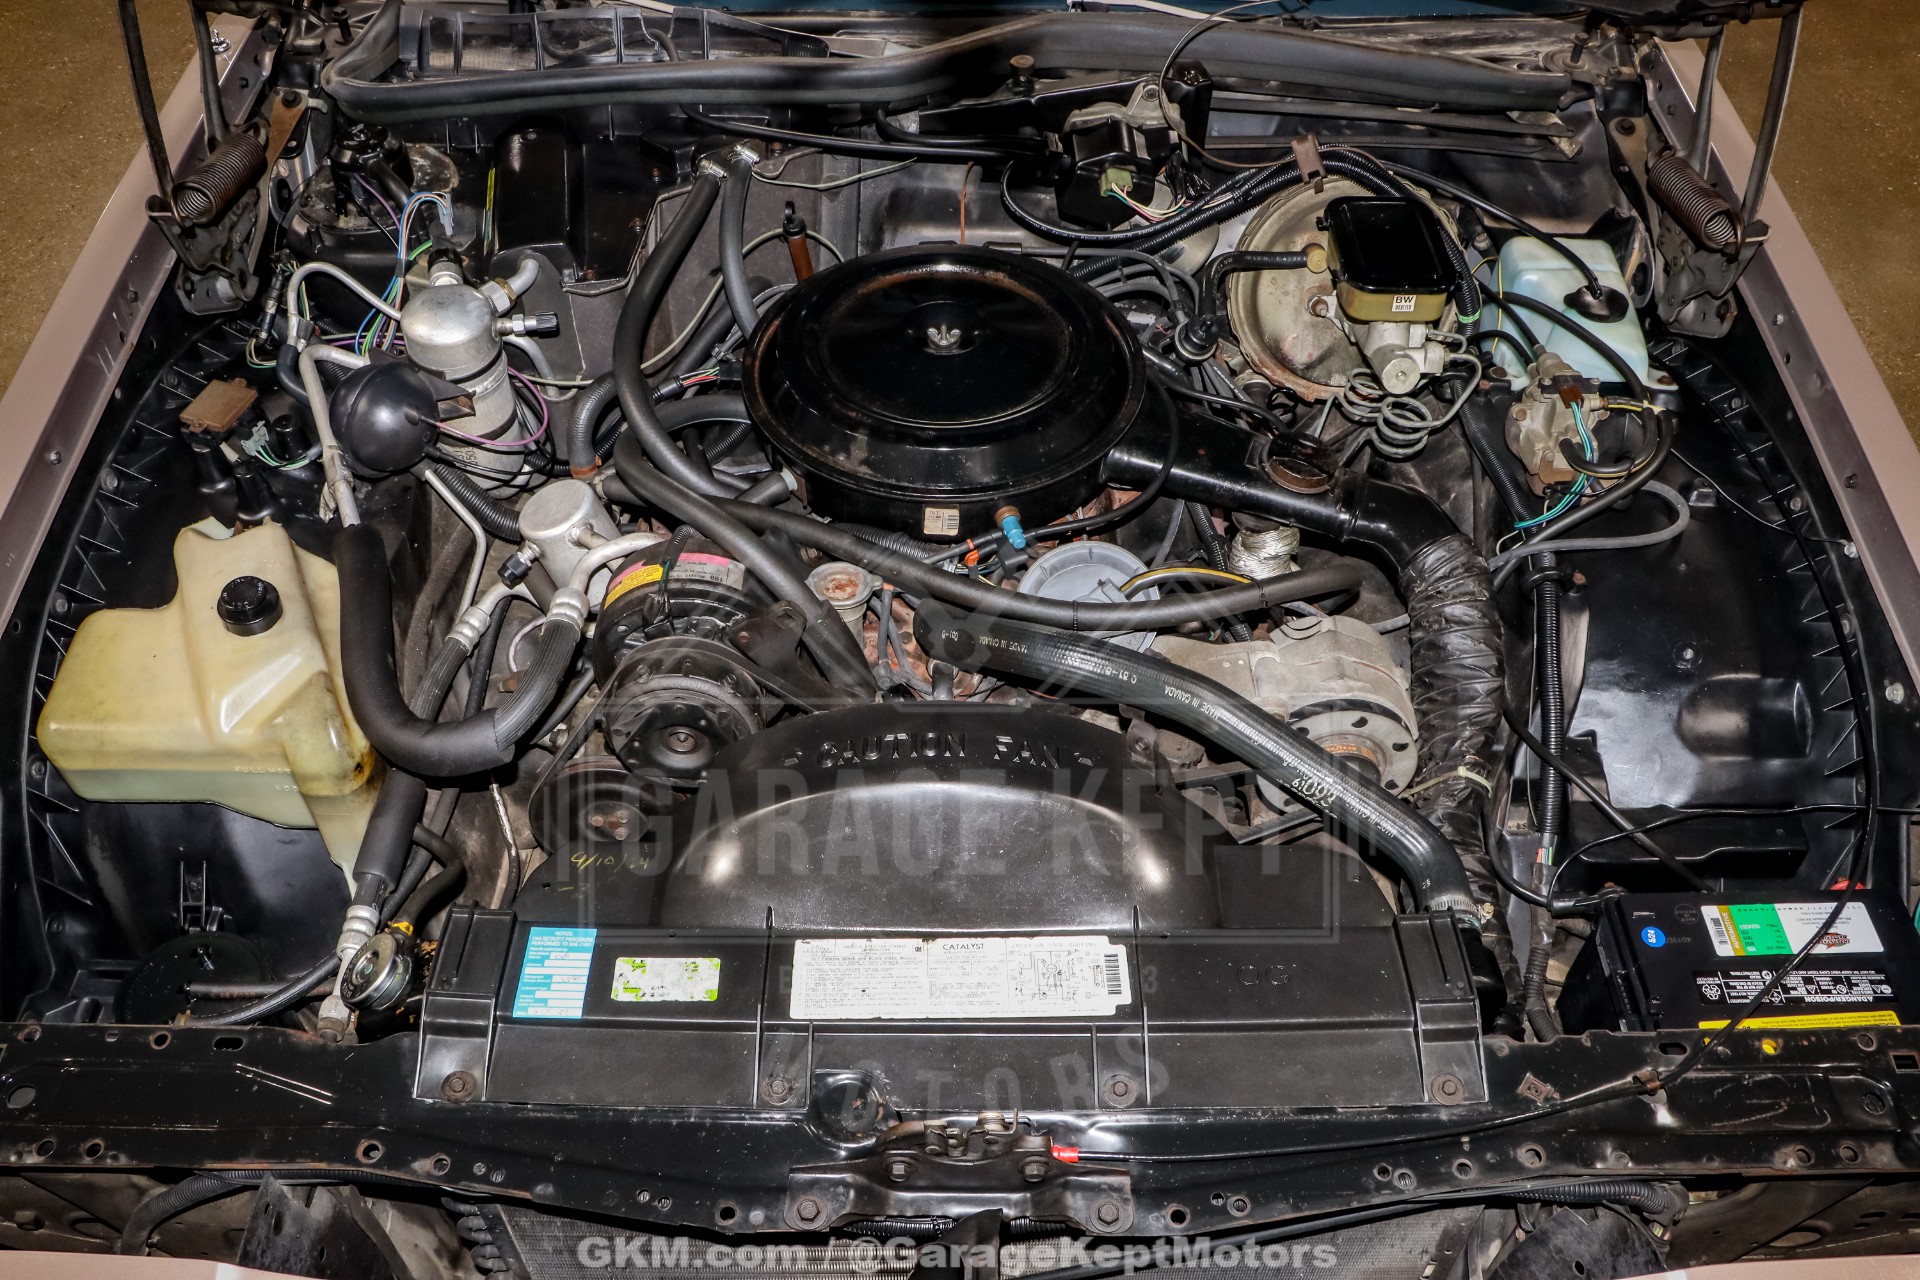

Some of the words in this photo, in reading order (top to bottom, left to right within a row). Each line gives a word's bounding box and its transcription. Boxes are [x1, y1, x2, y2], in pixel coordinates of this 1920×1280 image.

[1395, 296, 1414, 304] BW
[1164, 684, 1192, 704] CANADA
[1191, 696, 1201, 708] IN
[1200, 701, 1220, 720] MADE
[816, 731, 967, 768] CAUTION
[994, 735, 1061, 769] FAN
[233, 766, 266, 774] FULL
[1721, 911, 1741, 949] AUTOMOTIVE
[942, 943, 985, 951] CATALYST
[1804, 995, 1867, 1004] DANGER/POISON
